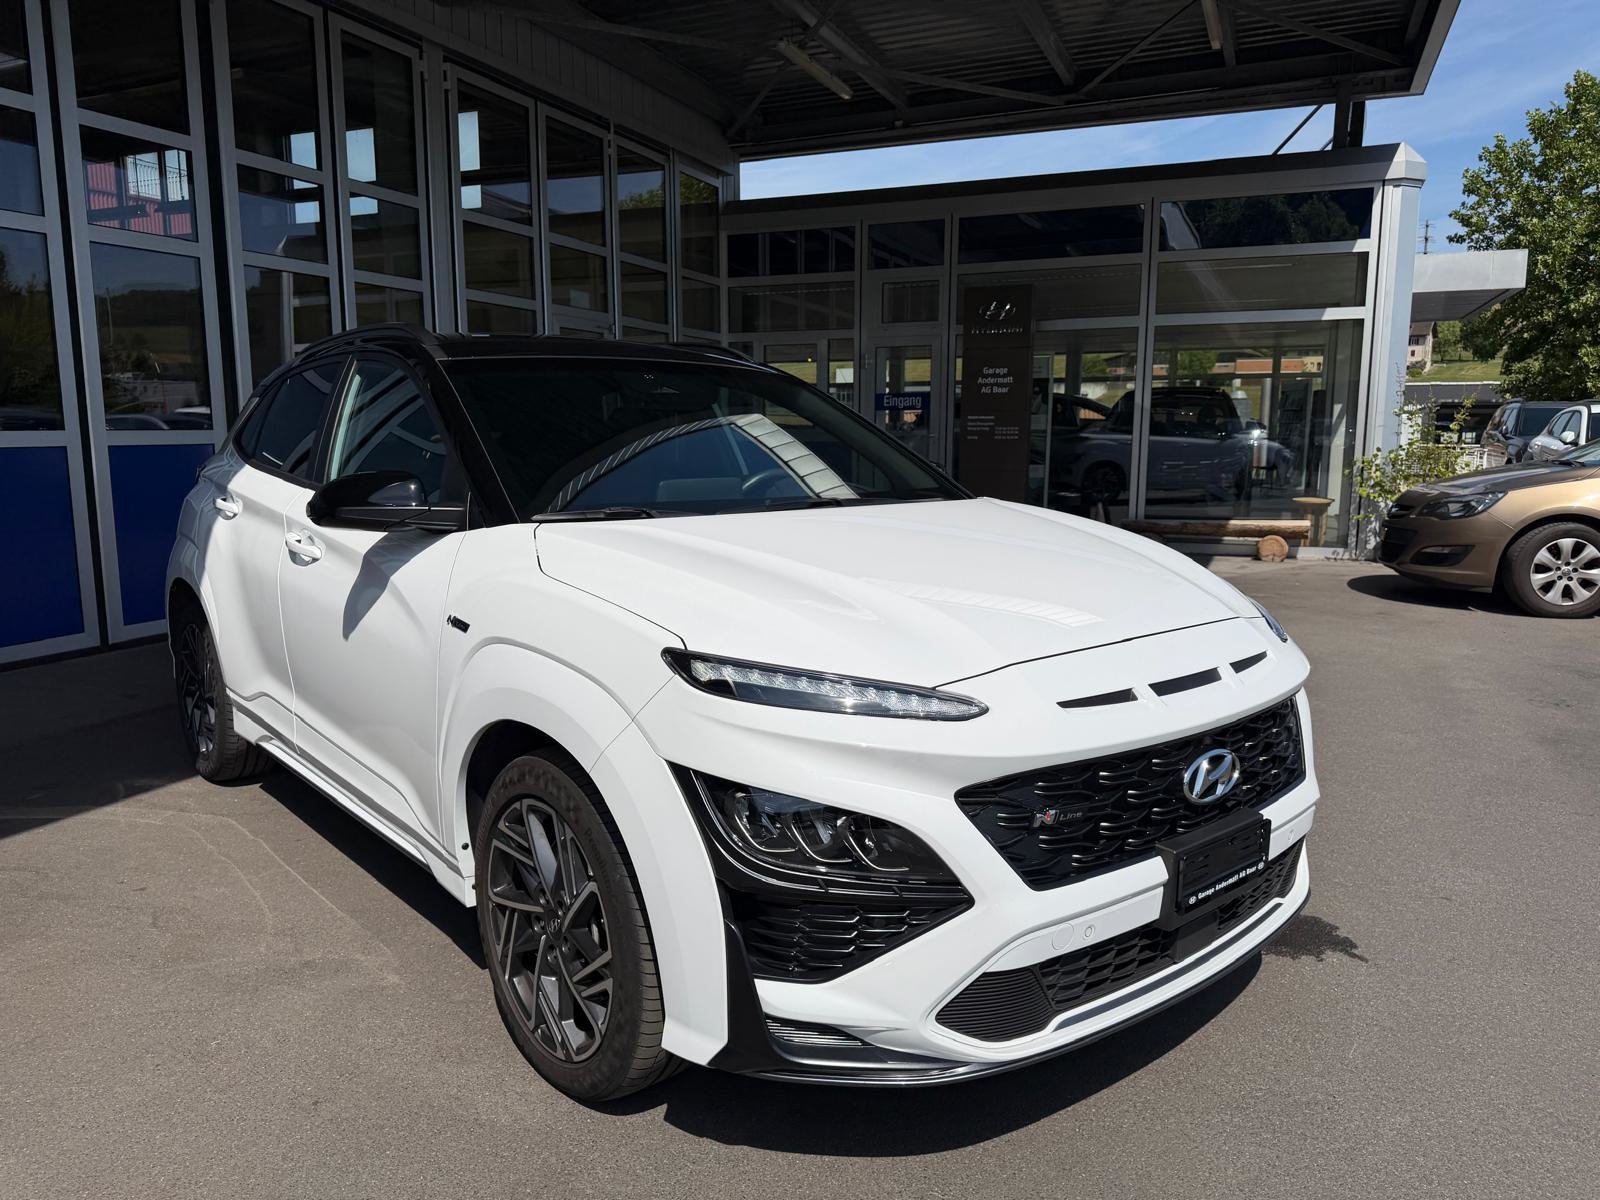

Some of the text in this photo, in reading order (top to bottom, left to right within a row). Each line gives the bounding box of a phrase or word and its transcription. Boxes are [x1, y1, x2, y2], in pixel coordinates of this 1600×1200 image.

[983, 366, 1008, 375] Garage
[977, 376, 1013, 385] Andermatt
[981, 385, 992, 394] AG
[883, 395, 922, 409] Eingang
[1059, 812, 1082, 821] Line
[1198, 865, 1257, 899] Garage Andermatt AG Baar
